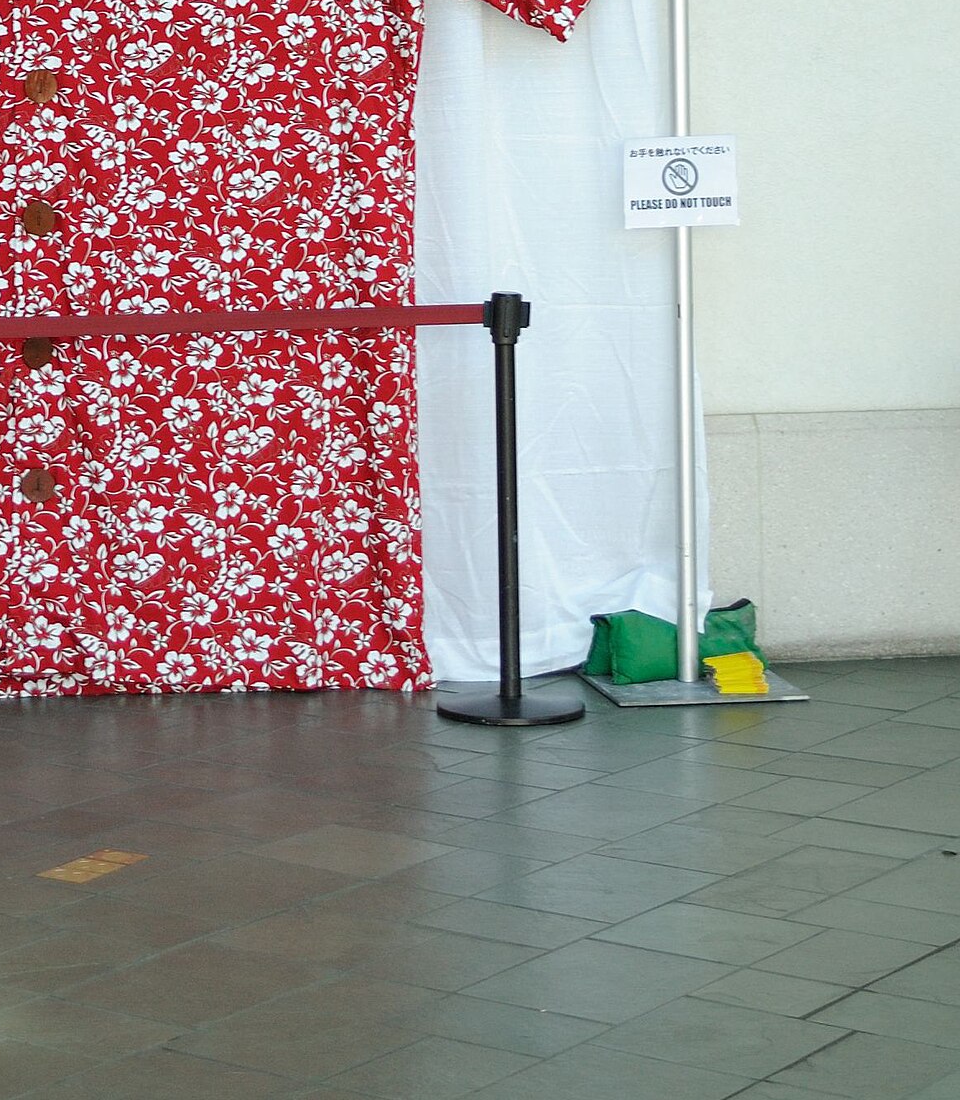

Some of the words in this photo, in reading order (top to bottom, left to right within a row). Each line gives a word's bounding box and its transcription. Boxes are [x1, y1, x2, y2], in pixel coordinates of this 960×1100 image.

[629, 146, 731, 158] お手を触れないでください
[630, 199, 663, 210] PLEASE
[665, 198, 678, 209] DO
[680, 197, 698, 209] NOT
[700, 196, 732, 208] TOUCH
